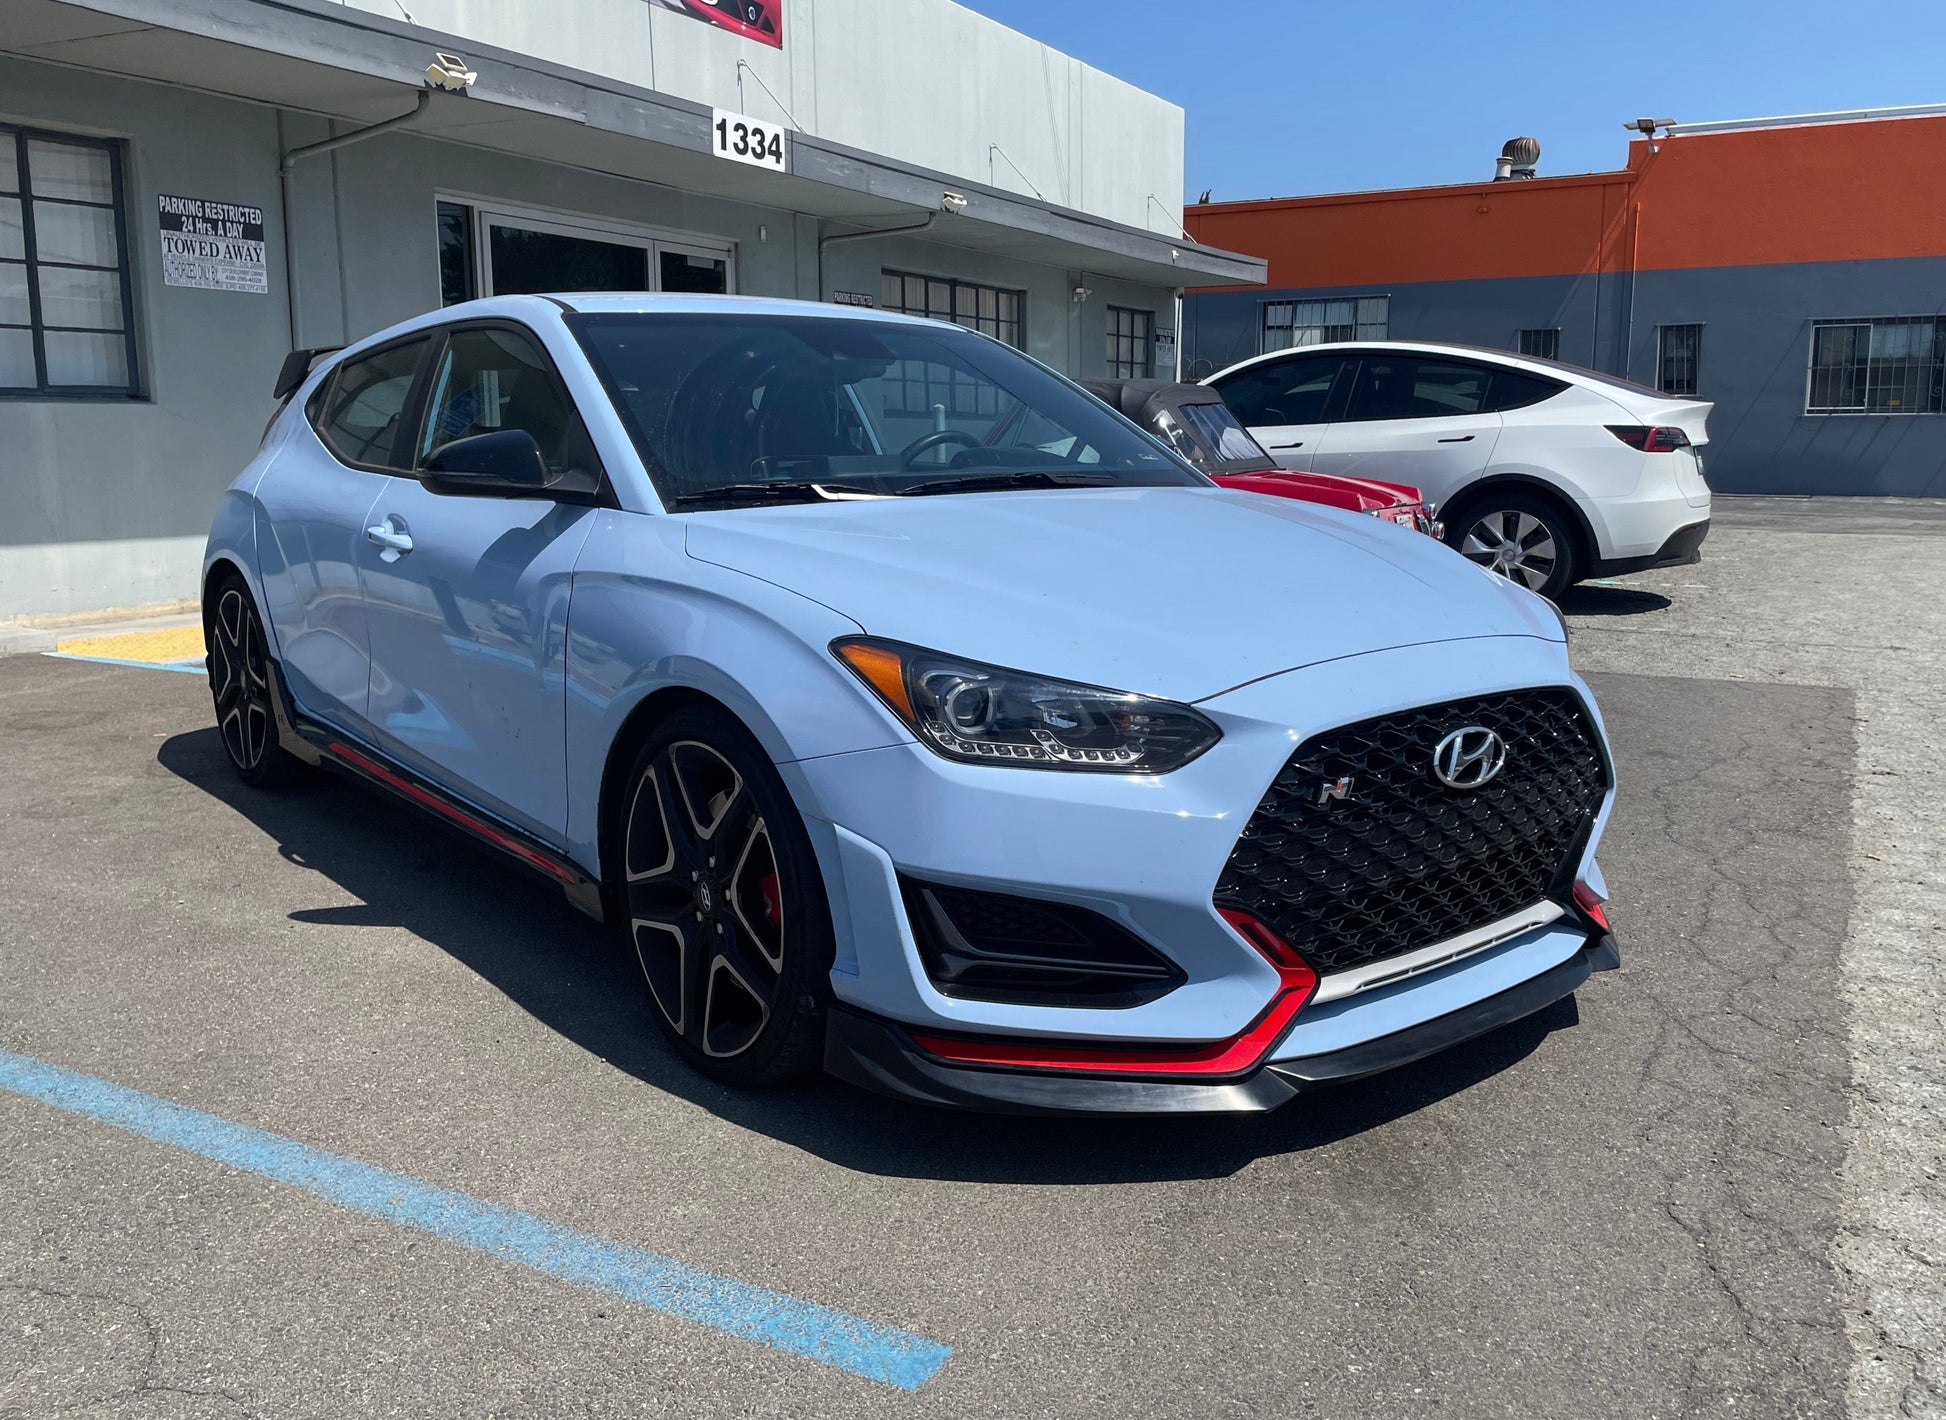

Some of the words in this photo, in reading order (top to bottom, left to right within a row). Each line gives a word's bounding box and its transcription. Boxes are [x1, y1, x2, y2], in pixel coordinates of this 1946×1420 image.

[716, 118, 782, 164] 1334
[158, 195, 202, 217] PARKING
[204, 202, 262, 225] RESTRICTED
[182, 216, 194, 232] 24
[196, 218, 215, 236] Hrs.
[217, 221, 225, 237] A
[226, 222, 243, 239] DAY
[164, 237, 220, 258] TOWED
[223, 245, 262, 263] AWAY
